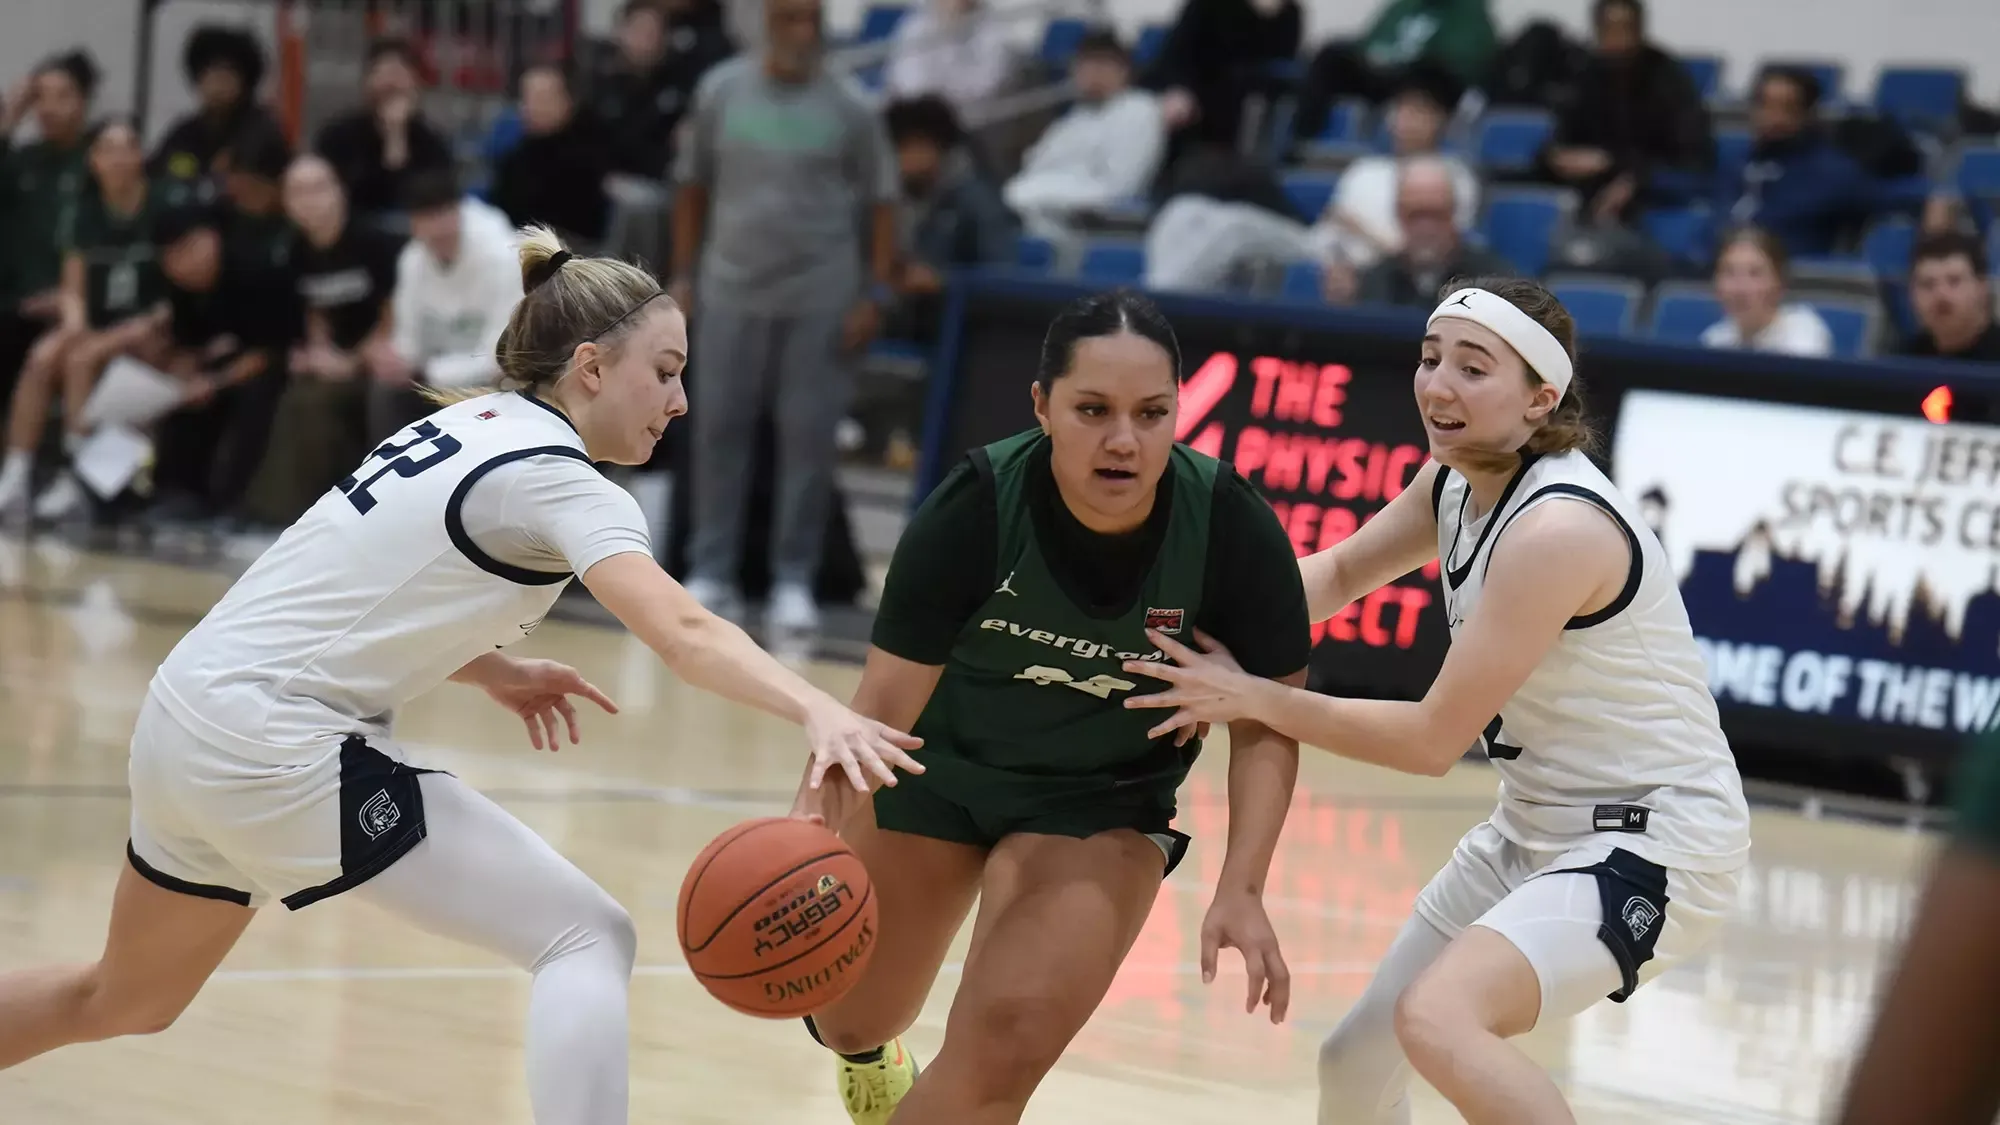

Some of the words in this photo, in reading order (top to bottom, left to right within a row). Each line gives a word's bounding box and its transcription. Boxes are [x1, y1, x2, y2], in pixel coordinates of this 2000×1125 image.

[1251, 356, 1351, 428] THE
[1777, 479, 1946, 546] SPORTS
[1782, 650, 1851, 713] OF
[1856, 658, 1951, 730] THE
[1629, 812, 1640, 823] M
[754, 880, 854, 957] LEGACY
[763, 917, 874, 1004] SPALDING
